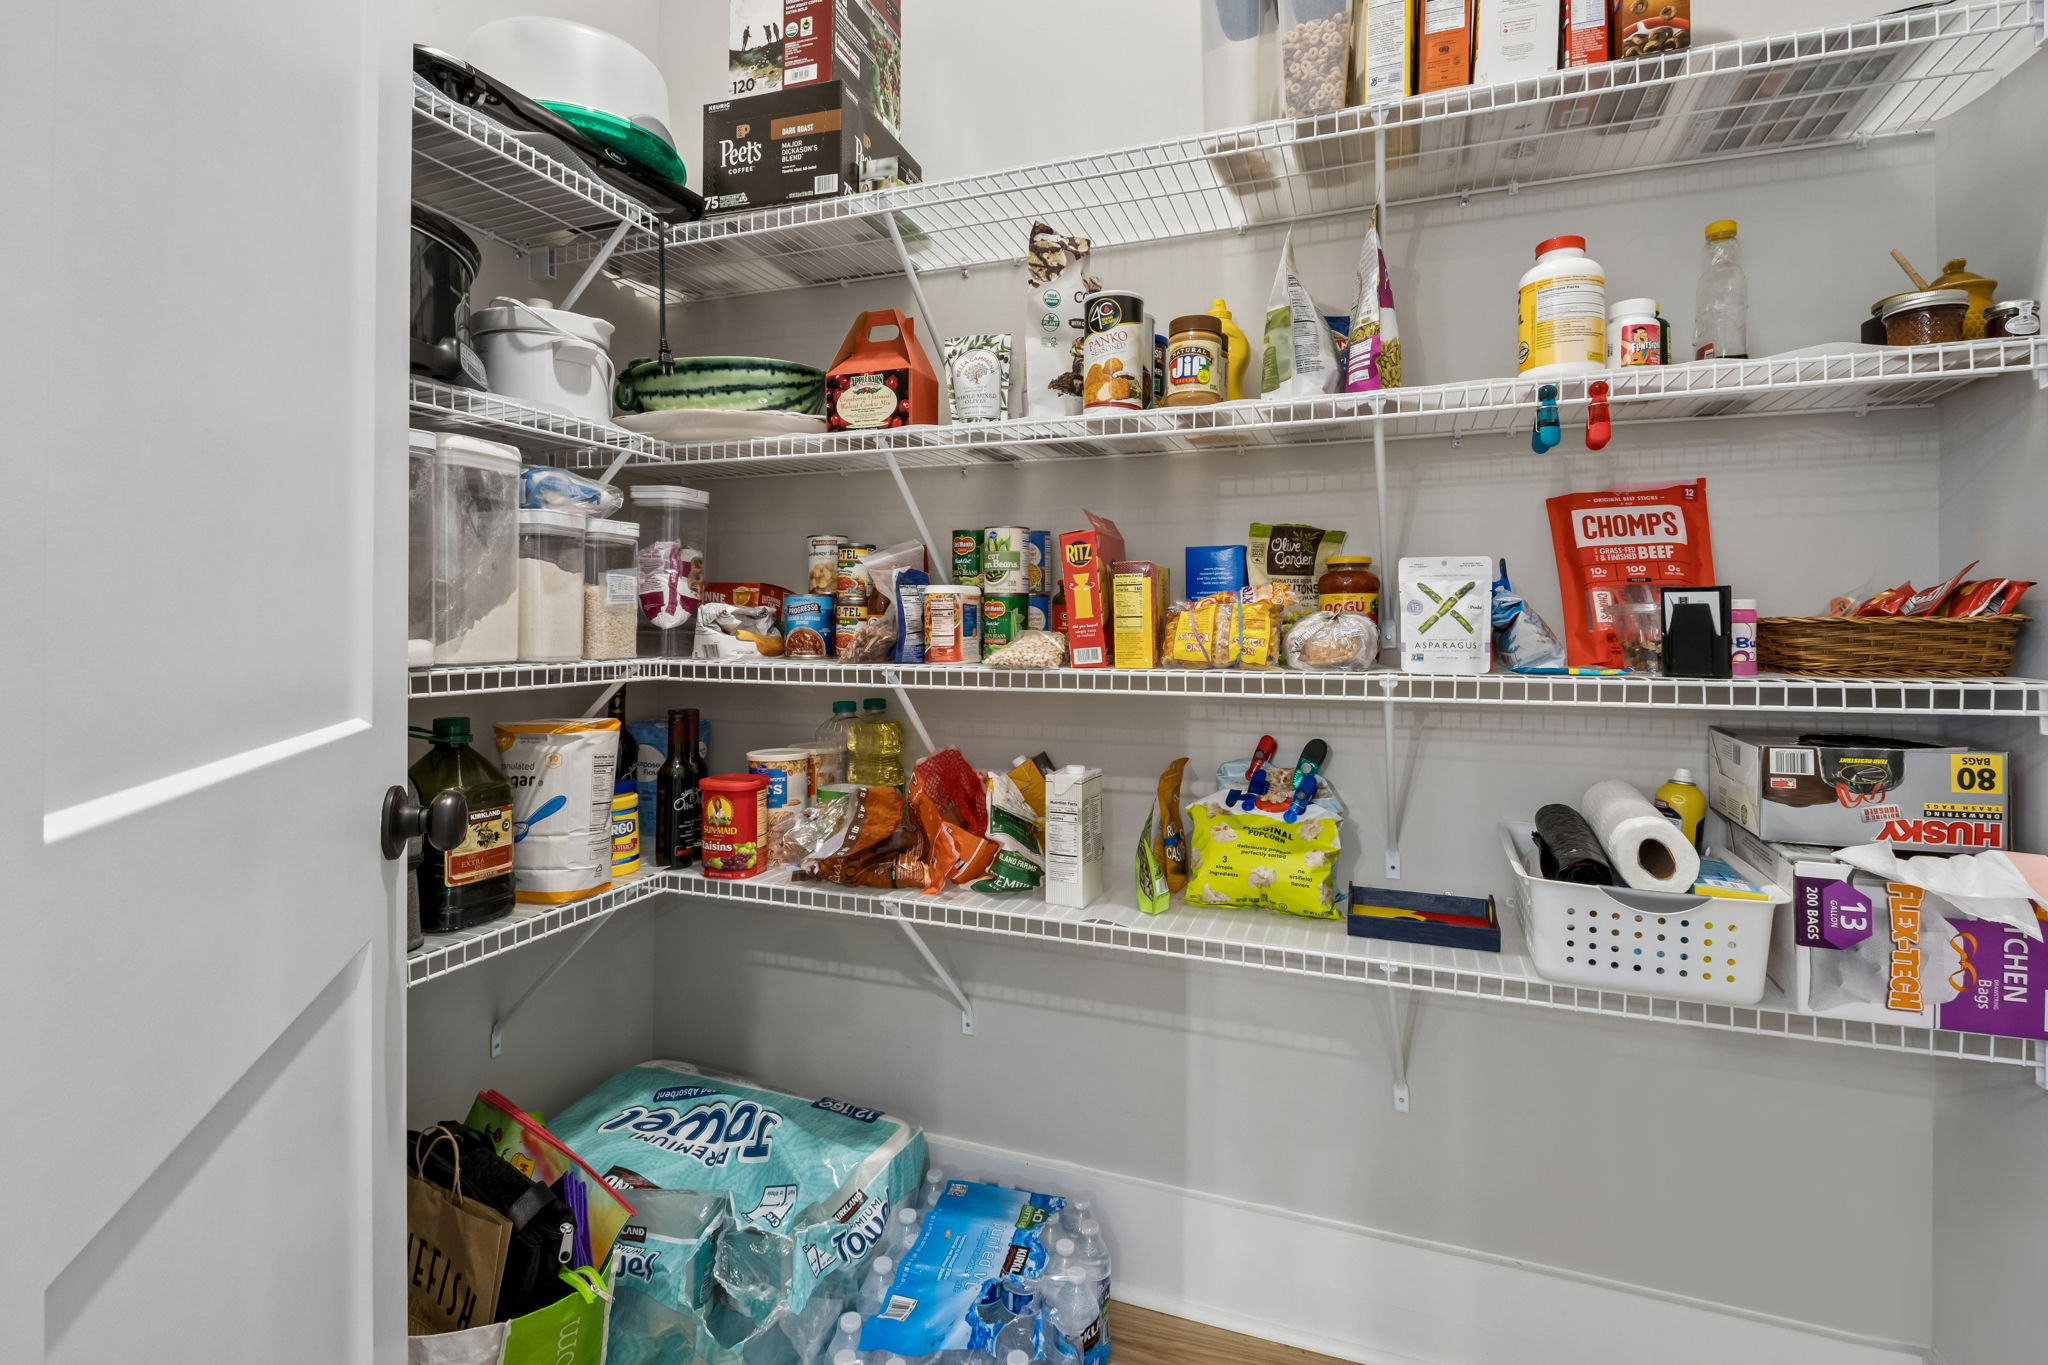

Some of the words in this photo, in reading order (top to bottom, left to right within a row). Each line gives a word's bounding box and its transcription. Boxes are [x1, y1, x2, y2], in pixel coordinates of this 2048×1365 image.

[733, 77, 755, 95] 120
[708, 102, 731, 111] KEURIG
[781, 126, 796, 136] DARK
[797, 123, 814, 133] ROAST
[781, 140, 803, 149] MAJOR
[781, 144, 818, 156] DICKASON'S
[719, 139, 762, 168] Peet's
[781, 153, 803, 163] BLEND
[728, 165, 755, 175] COFFEE
[704, 195, 719, 211] 75
[1088, 330, 1128, 351] PANKO
[1172, 347, 1207, 358] NATURAL
[1172, 354, 1207, 378] Jif
[976, 392, 997, 400] MIXED
[1684, 488, 1694, 497] 12
[1582, 511, 1678, 540] CHOMPS
[1271, 537, 1301, 552] Olive
[1638, 544, 1674, 560] BEEF
[1066, 544, 1092, 562] RITZ
[1274, 551, 1313, 568] Garden
[993, 560, 1018, 568] Beans
[788, 604, 819, 615] PROGRESSO
[1414, 642, 1478, 650] ASPARAGUS
[1962, 757, 1990, 766] BAGS
[1956, 768, 1997, 792] 80
[470, 809, 501, 820] KIRKLAND
[1926, 810, 2000, 820] DRAWSTRING
[611, 820, 634, 836] RGO
[703, 825, 738, 835] SUN-MAID
[1875, 818, 2002, 848] HUSKY
[1248, 829, 1286, 844] POPCORN
[1236, 843, 1268, 851] deliciously
[1240, 849, 1266, 858] perfectly
[461, 858, 485, 868] EXTRA
[1017, 860, 1038, 872] FARMS
[1210, 870, 1239, 878] ingredients
[1289, 874, 1313, 882] artificial
[1806, 886, 1818, 906] 200
[1830, 899, 1838, 928] GALLON
[1840, 901, 1868, 931] 13
[1806, 909, 1820, 940] BAGS
[1886, 881, 1925, 1013] FLEX-TECH
[2003, 926, 2030, 1004] TCHEN
[1974, 979, 1993, 1009] Bags
[656, 1087, 699, 1100] Absorbent
[602, 1103, 777, 1158] Towel
[632, 1132, 729, 1168] PREMIUM
[1033, 1208, 1045, 1222] 40
[1010, 1248, 1028, 1275] KIRKL
[409, 1234, 478, 1330] EFISH
